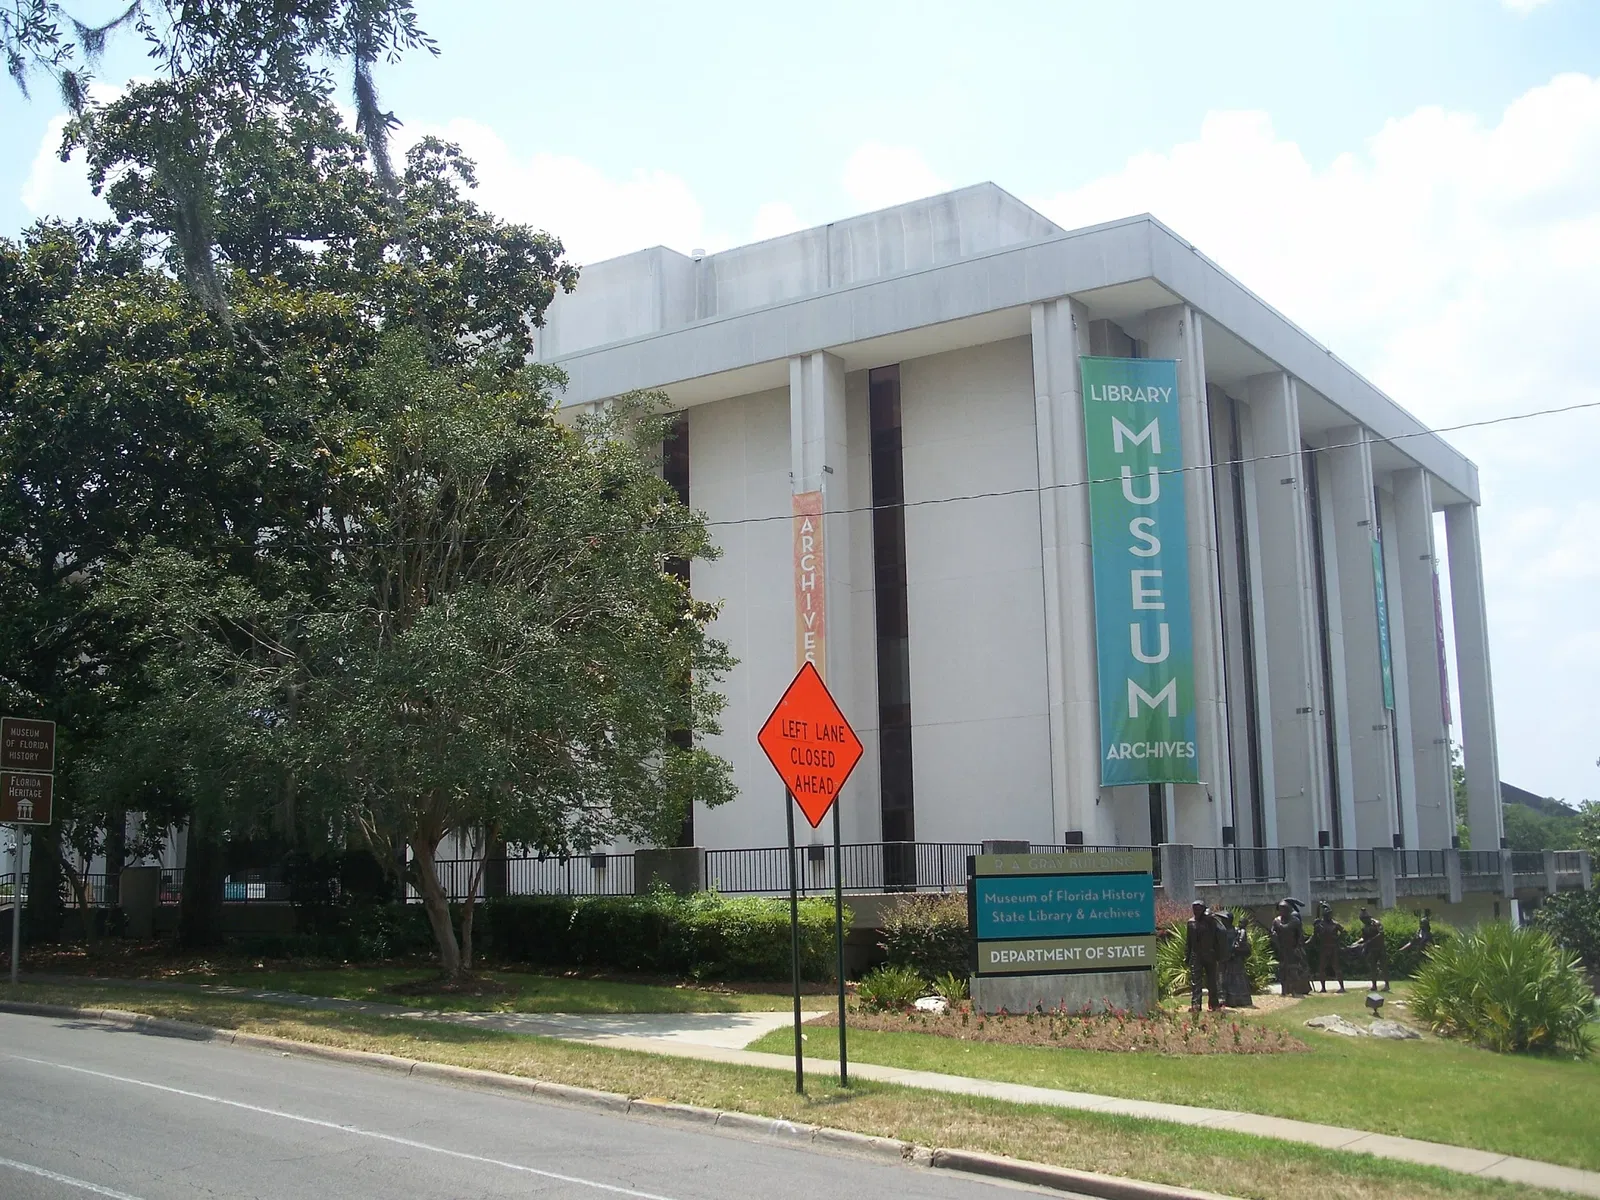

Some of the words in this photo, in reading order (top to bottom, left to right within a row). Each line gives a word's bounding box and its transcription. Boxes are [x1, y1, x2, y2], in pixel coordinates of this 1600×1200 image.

[1090, 384, 1172, 403] LIBRARY
[1111, 415, 1177, 718] MUSEUM
[10, 728, 40, 738] MUSEUM
[782, 719, 808, 741] LEFT
[816, 723, 846, 743] LANE
[6, 739, 15, 748] OF
[20, 740, 49, 750] FLORIDA
[1106, 741, 1195, 760] ARCHIVES
[9, 751, 39, 761] HISTORY
[790, 747, 836, 769] CLOSED
[11, 776, 41, 787] FLORIDA
[795, 774, 834, 795] AHEAD
[9, 787, 42, 798] HERITAGE
[1028, 857, 1064, 870] GRAY
[1069, 855, 1135, 869] BUILDING
[985, 893, 1037, 904] Museum
[1040, 890, 1053, 902] of
[1057, 890, 1099, 902] Florida
[1102, 889, 1146, 904] History
[992, 910, 1025, 923] State
[1029, 909, 1073, 923] Library
[1076, 909, 1085, 920] &
[1089, 907, 1141, 919] Archives
[990, 947, 1082, 963] DEPARTMENT
[1085, 946, 1104, 960] OF
[1107, 945, 1146, 958] STATE
